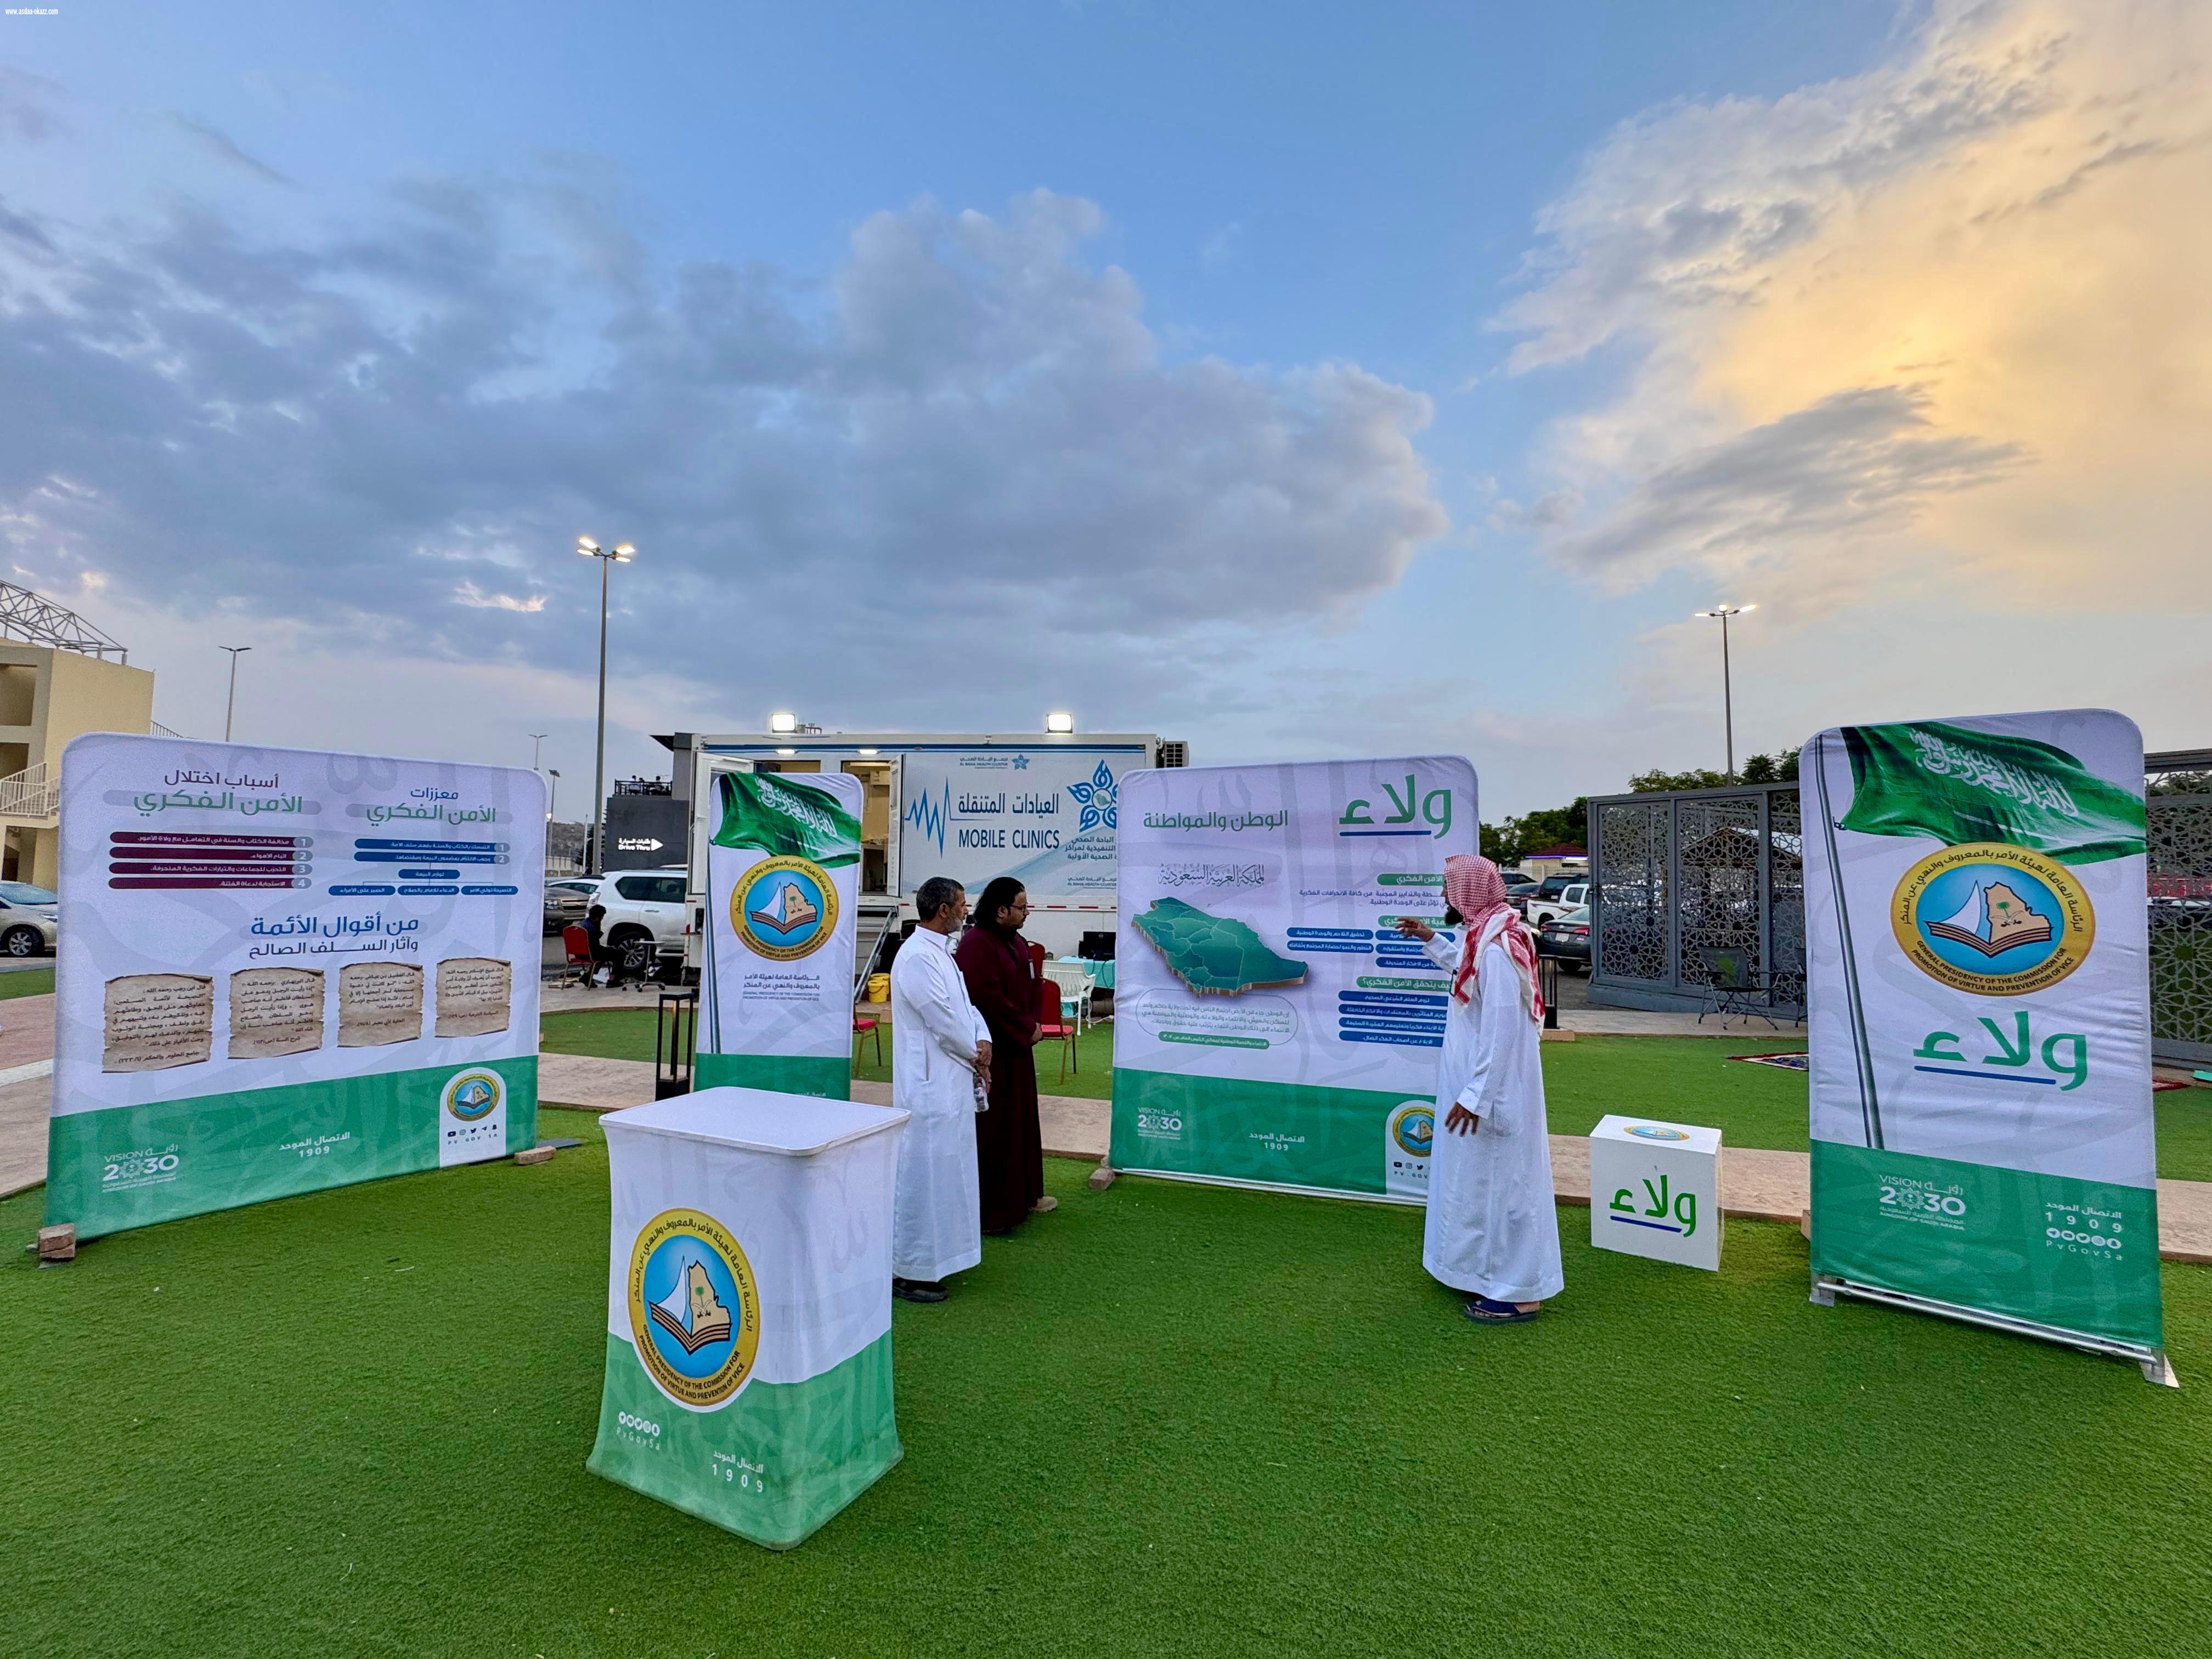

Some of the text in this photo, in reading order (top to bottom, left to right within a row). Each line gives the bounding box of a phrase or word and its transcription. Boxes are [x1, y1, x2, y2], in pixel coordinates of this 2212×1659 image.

[165, 770, 279, 790] أسباب اختلال
[410, 787, 459, 802] معززات
[134, 789, 302, 817] الأمن الفكري
[958, 792, 1059, 819] العيادات المتنقلة
[1339, 774, 1452, 840] ولاء
[367, 803, 496, 827] الأمن الفكري
[1143, 809, 1288, 832] الوطن والمواطنة
[211, 837, 222, 845] في
[300, 838, 306, 847] 1
[958, 828, 1060, 849] MOBILE CLINICS
[1071, 836, 1115, 845] الباحة الصحي
[300, 851, 306, 860] 2
[1064, 844, 1085, 853] لمراكز
[1944, 849, 1994, 864] بالمعروف
[1996, 850, 2019, 861] الأمر
[1067, 853, 1088, 861] الأولية
[2019, 855, 2048, 874] لهيئة
[300, 865, 306, 873] 3
[1916, 862, 1944, 886] والنهي
[298, 879, 305, 888] 4
[1396, 874, 1443, 885] الأمن الفكري
[2046, 872, 2072, 900] العامة
[1908, 884, 1917, 898] عن
[1900, 898, 1912, 925] المنكر
[251, 911, 419, 938] من أقوال الأئمة
[249, 942, 306, 960] الصالح
[389, 936, 419, 953] وآثار
[1911, 949, 1948, 979] PROMOTION
[1948, 975, 1959, 984] OF
[1959, 979, 1985, 991] VIRTUE
[2006, 973, 2053, 992] PREVENTION
[2052, 968, 2062, 979] OF
[2058, 957, 2074, 972] VICE
[1917, 940, 1939, 967] GENERAL
[1939, 962, 1984, 983] PRESIDENCY
[1997, 977, 2013, 985] THE
[2013, 958, 2058, 983] COMMISSION
[2055, 947, 2067, 961] FOR
[758, 973, 774, 981] لهيئة
[1393, 979, 1412, 988] الأمن
[1413, 980, 1436, 989] يتحقق
[772, 982, 793, 991] والنهي
[793, 982, 820, 990] بالمعروف
[1913, 1011, 2087, 1092] ولاء
[1137, 1106, 1160, 1115] VISION
[278, 1131, 350, 1150] الاتصال الموحد
[1249, 1132, 1305, 1143] الاتصال الموحد
[299, 1146, 330, 1158] 1909
[1264, 1142, 1289, 1151] 1909
[104, 1150, 143, 1163] VISION
[1880, 1174, 1922, 1188] VISION
[1609, 1174, 1696, 1238] ولاء
[2046, 1201, 2122, 1219] الاتصال الموحد
[663, 1218, 697, 1231] بالمعروف
[697, 1222, 713, 1236] الأمر
[644, 1227, 664, 1256] والنهي
[713, 1231, 733, 1256] لهيئة
[639, 1253, 645, 1269] عن
[730, 1254, 748, 1289] العامة
[643, 1324, 656, 1356] GENERAL
[656, 1355, 684, 1386] PRESIDENCY
[703, 1365, 732, 1389] COMMISSION
[729, 1350, 740, 1368] FOR
[639, 1335, 745, 1400] PROMOTION OF VIRTUE AND PREVENTION OF VICE
[713, 1449, 764, 1474] الاتصال الموحد
